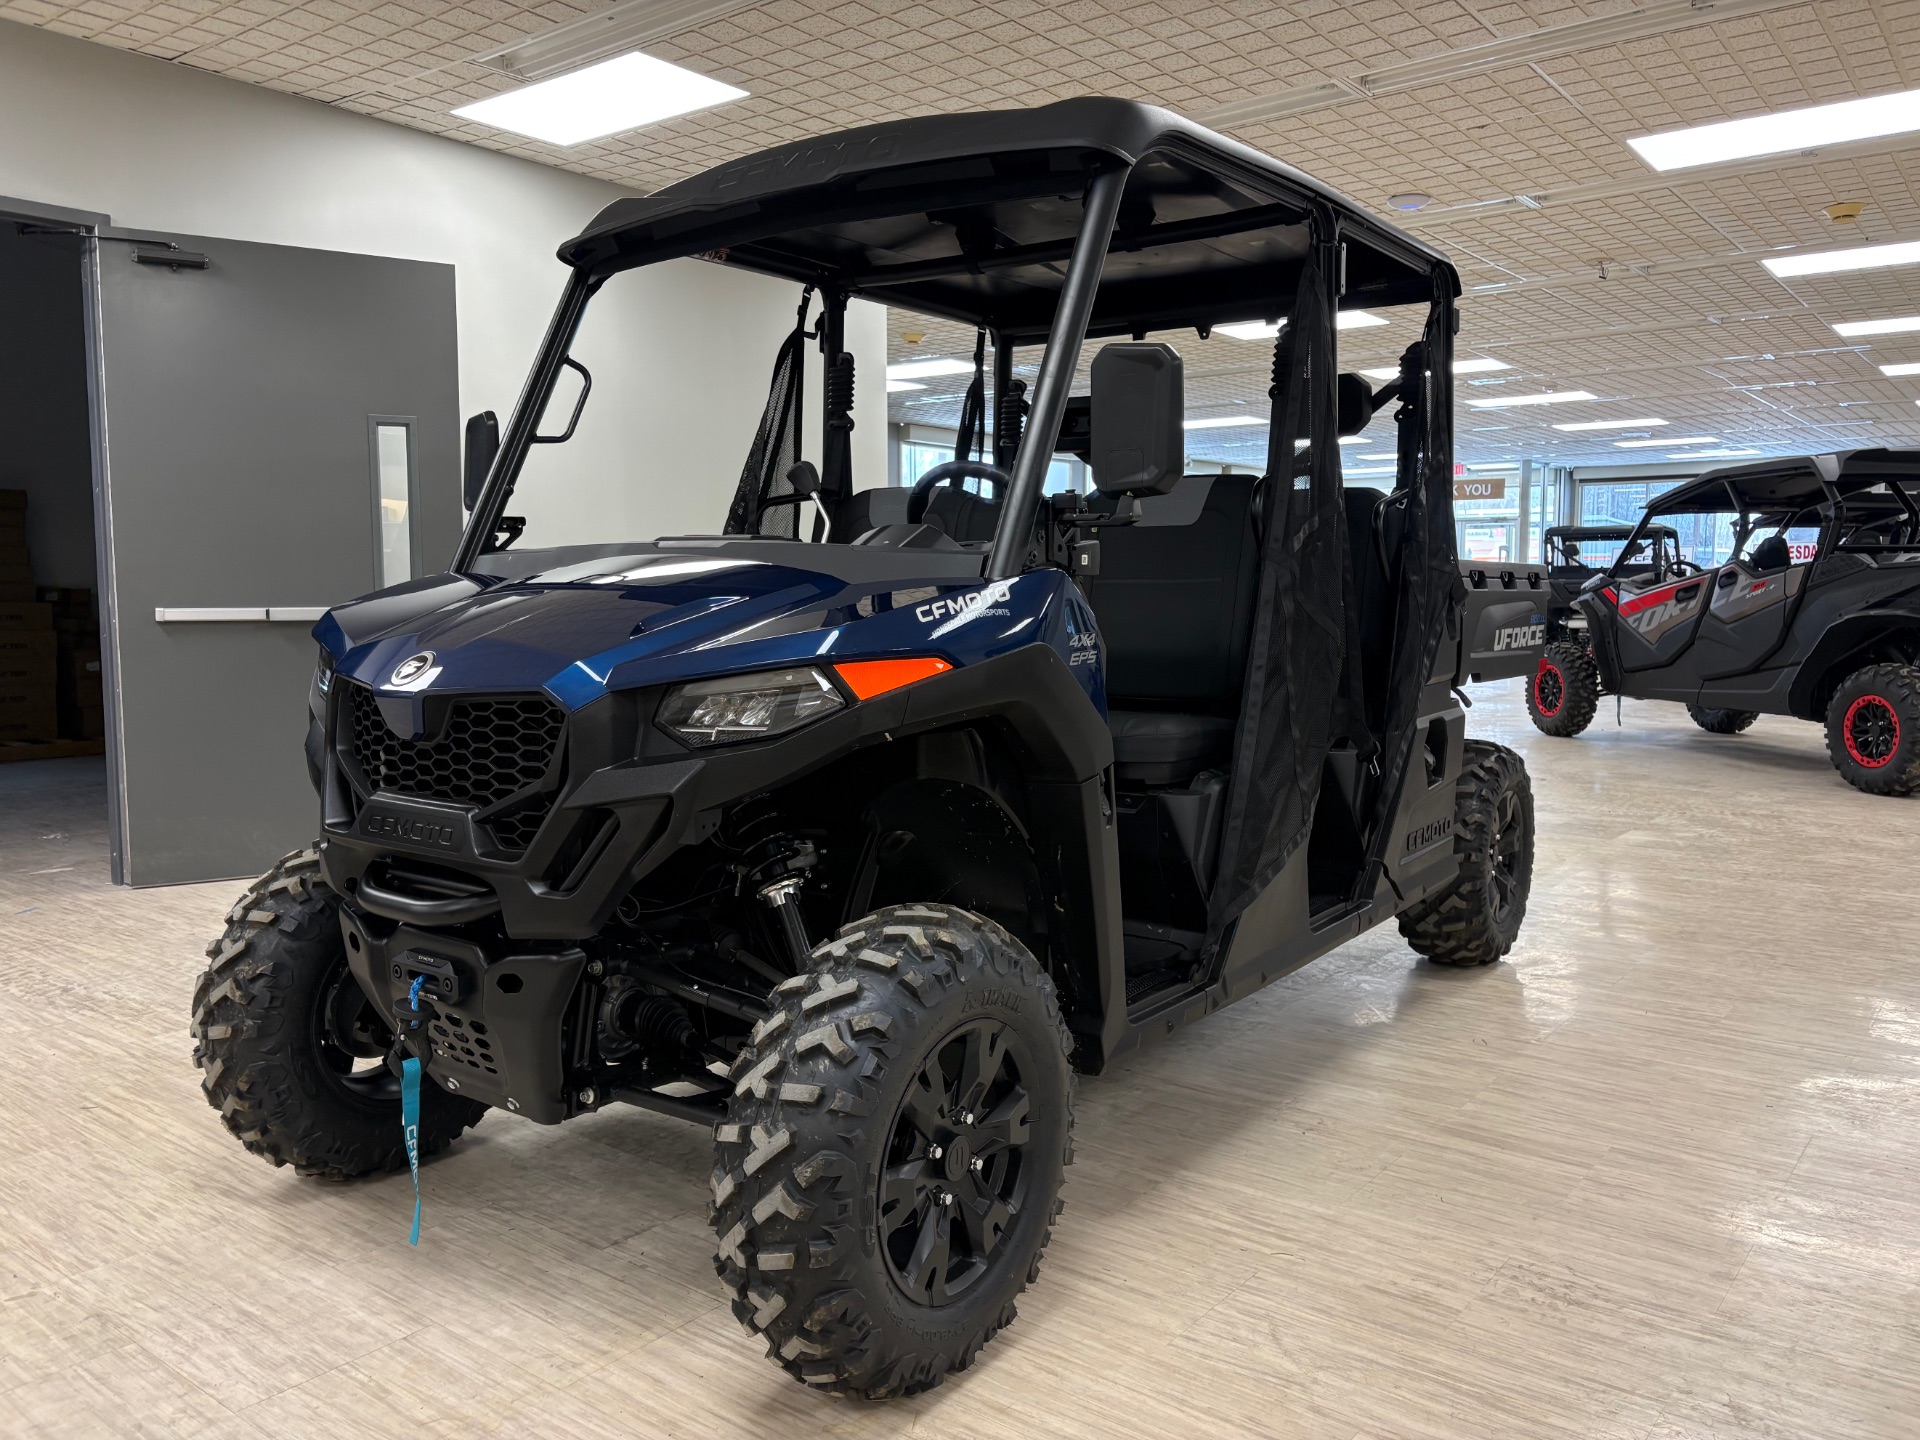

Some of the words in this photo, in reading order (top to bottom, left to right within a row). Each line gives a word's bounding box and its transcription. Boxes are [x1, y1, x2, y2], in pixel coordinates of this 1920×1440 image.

[1464, 484, 1491, 496] YOU
[1635, 554, 1687, 562] CFTO
[1788, 544, 1818, 560] ESDA
[916, 585, 1011, 623] CFMOTO
[1069, 633, 1096, 647] 4X4
[1494, 625, 1545, 651] UFORCE
[1069, 650, 1097, 665] EPS
[368, 816, 453, 845] CFMOTO
[1406, 818, 1451, 851] CFMOTO
